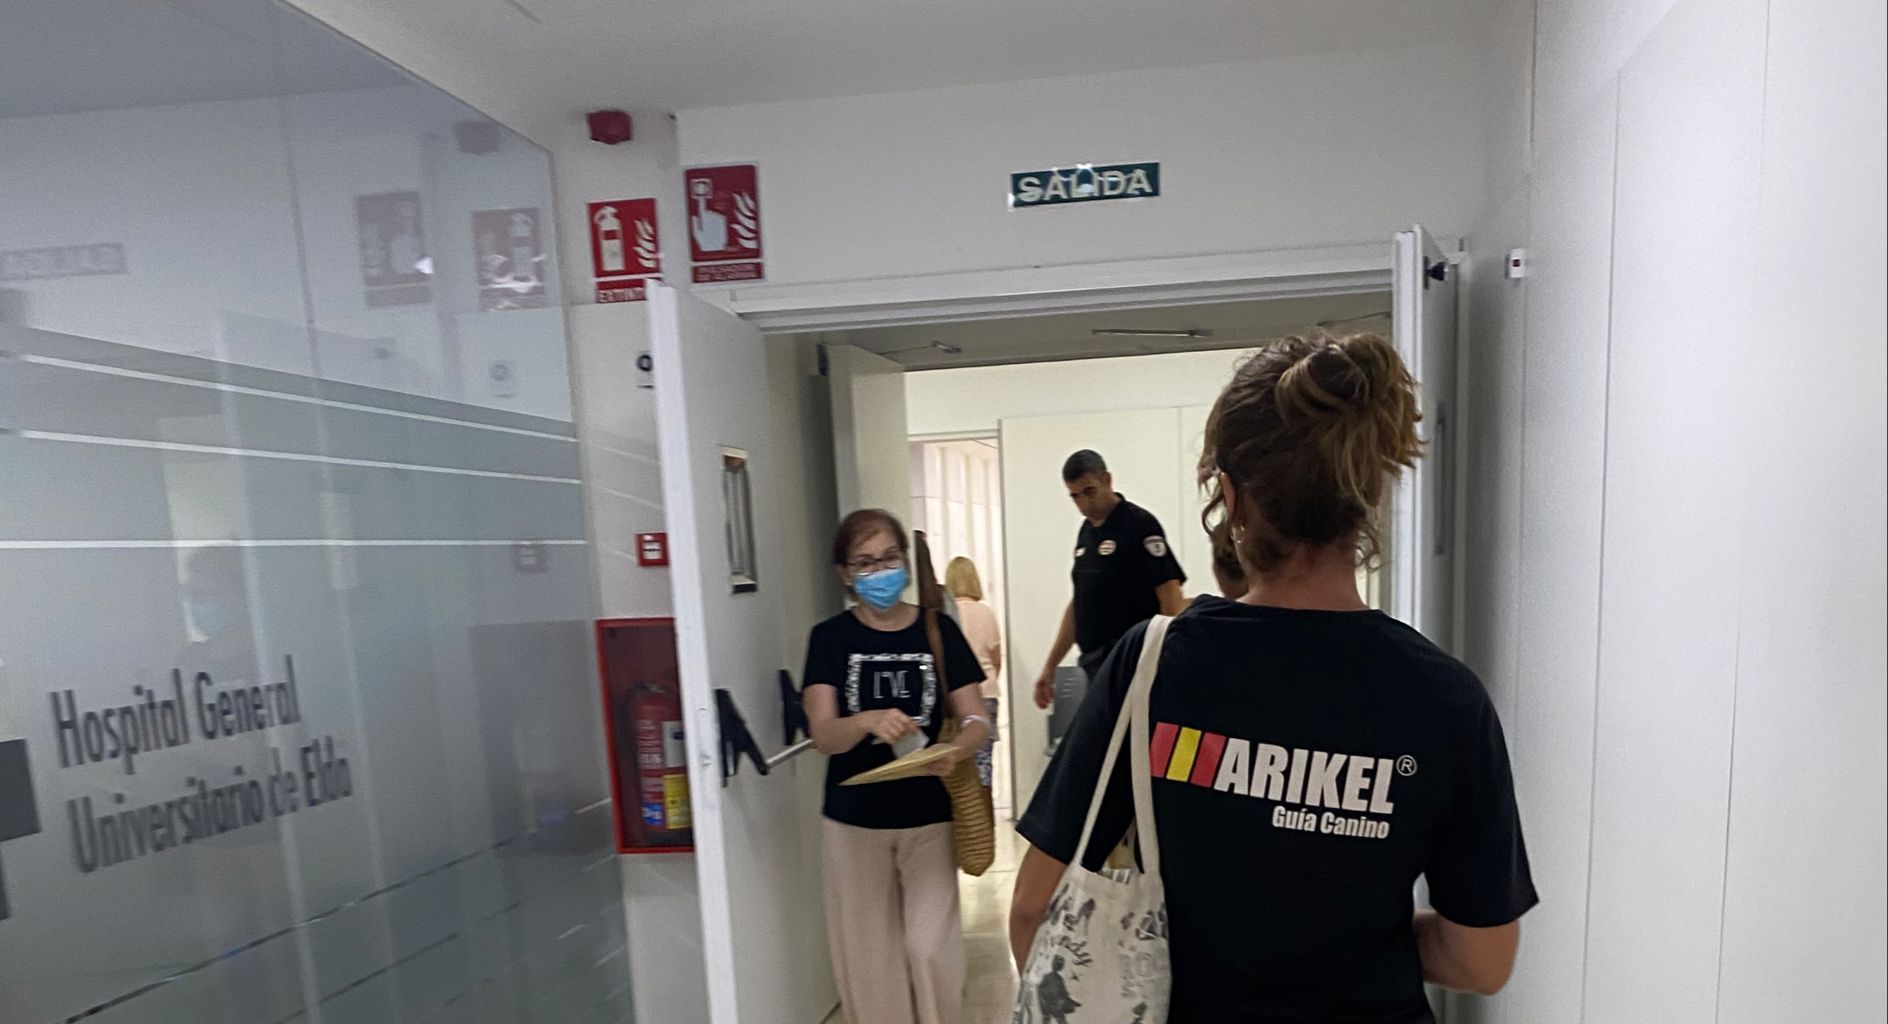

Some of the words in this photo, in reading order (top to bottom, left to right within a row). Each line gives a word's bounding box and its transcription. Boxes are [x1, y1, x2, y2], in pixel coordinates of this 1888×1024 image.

[1016, 169, 1153, 203] SALIDA
[49, 667, 190, 775] Hospital
[194, 653, 302, 741] General
[67, 765, 265, 874] Universitario
[267, 747, 300, 818] de
[1271, 804, 1316, 833] Guía
[1319, 811, 1391, 839] Canino
